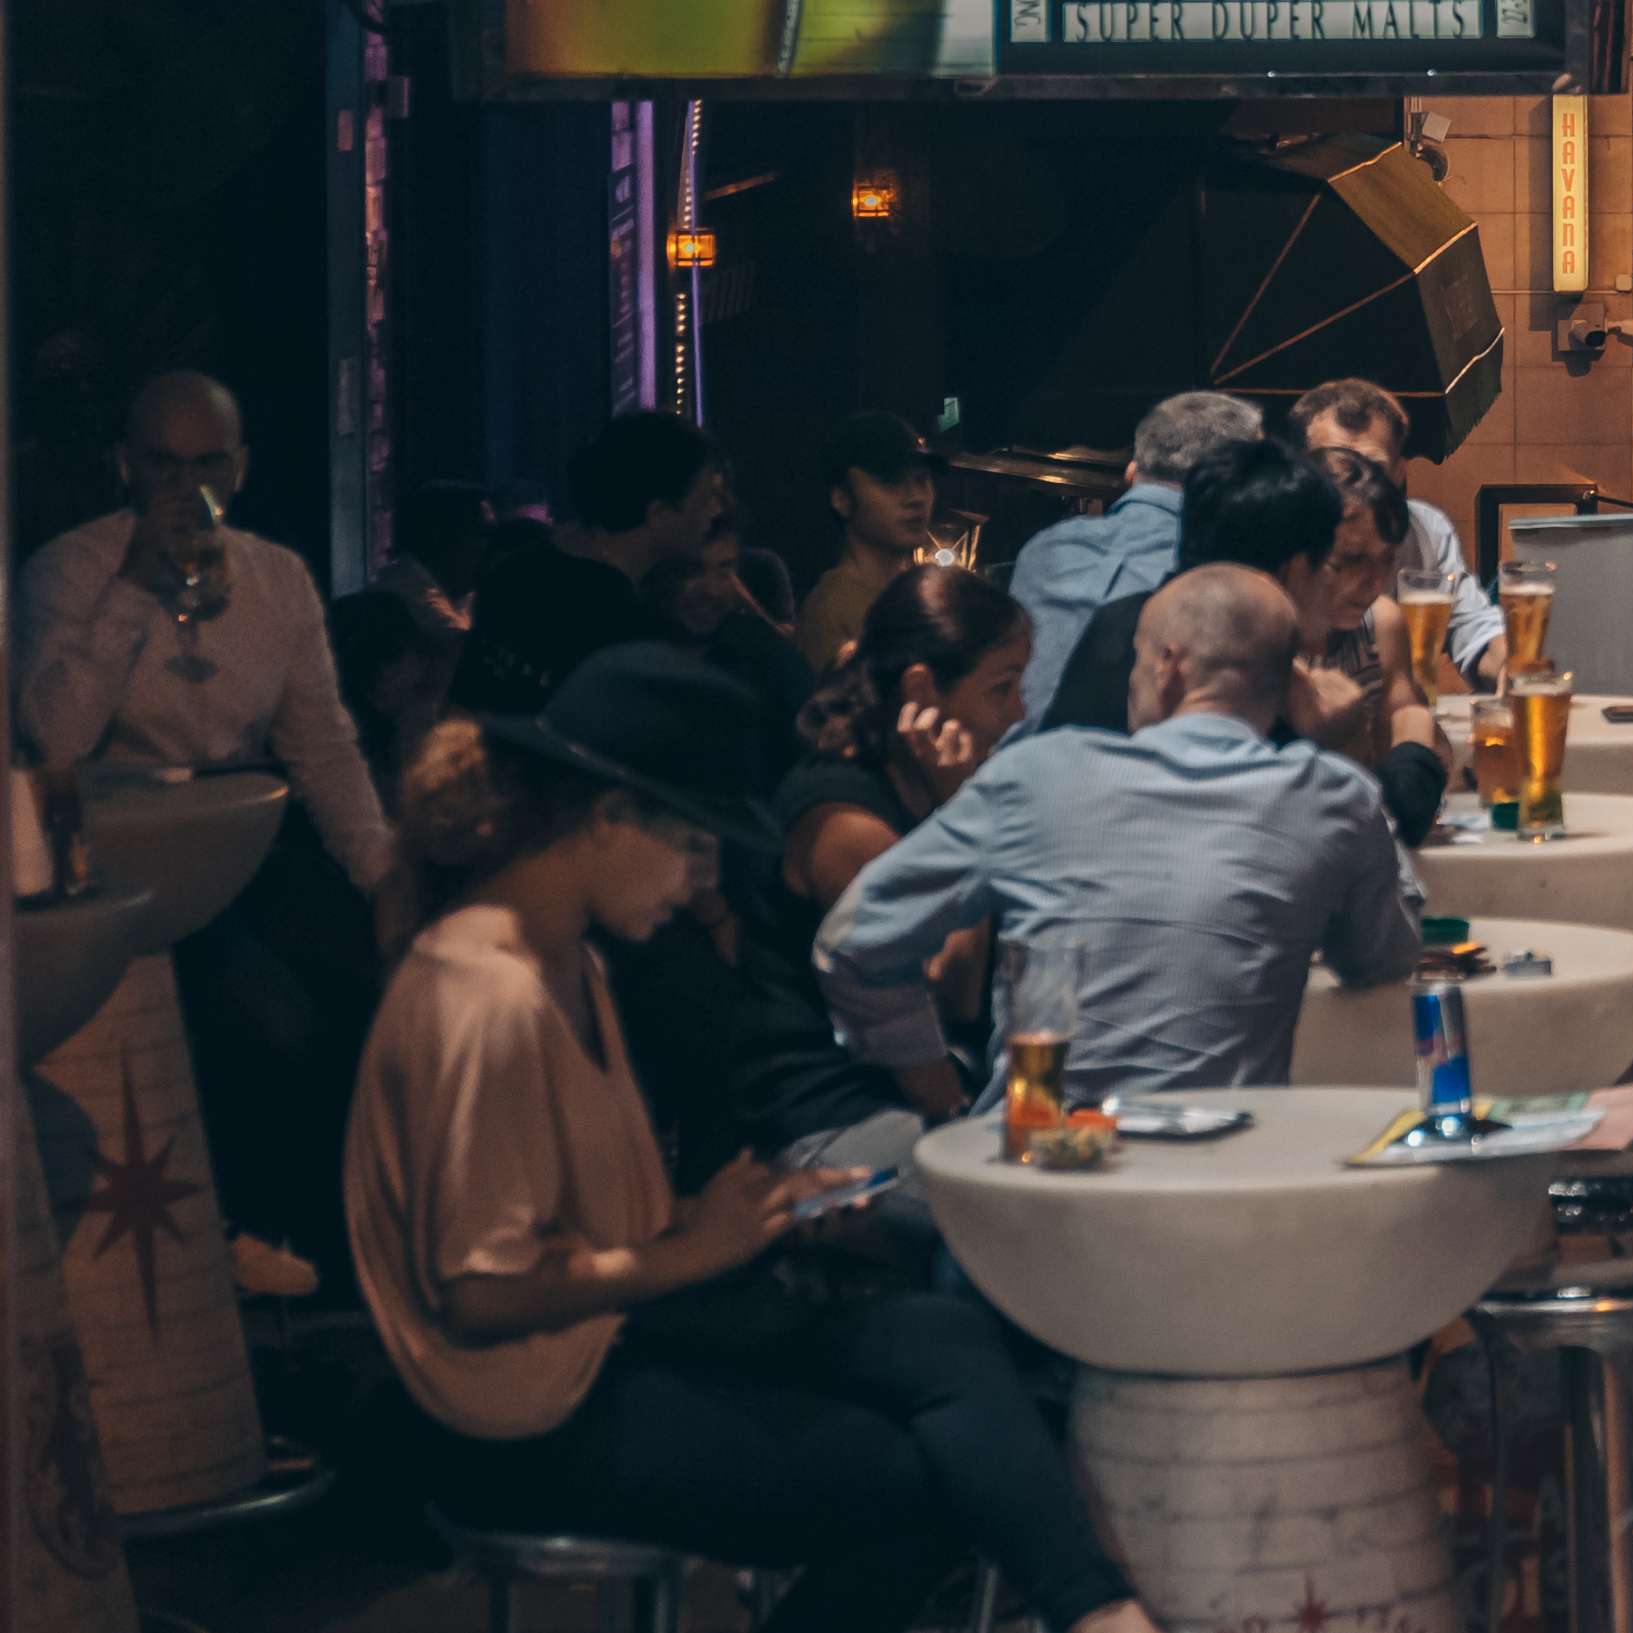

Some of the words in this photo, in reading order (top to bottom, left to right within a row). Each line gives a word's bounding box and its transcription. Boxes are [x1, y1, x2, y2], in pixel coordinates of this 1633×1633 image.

[1075, 2, 1184, 42] SUPER
[1211, 2, 1325, 41] DUPER
[1352, 0, 1466, 40] MALTS
